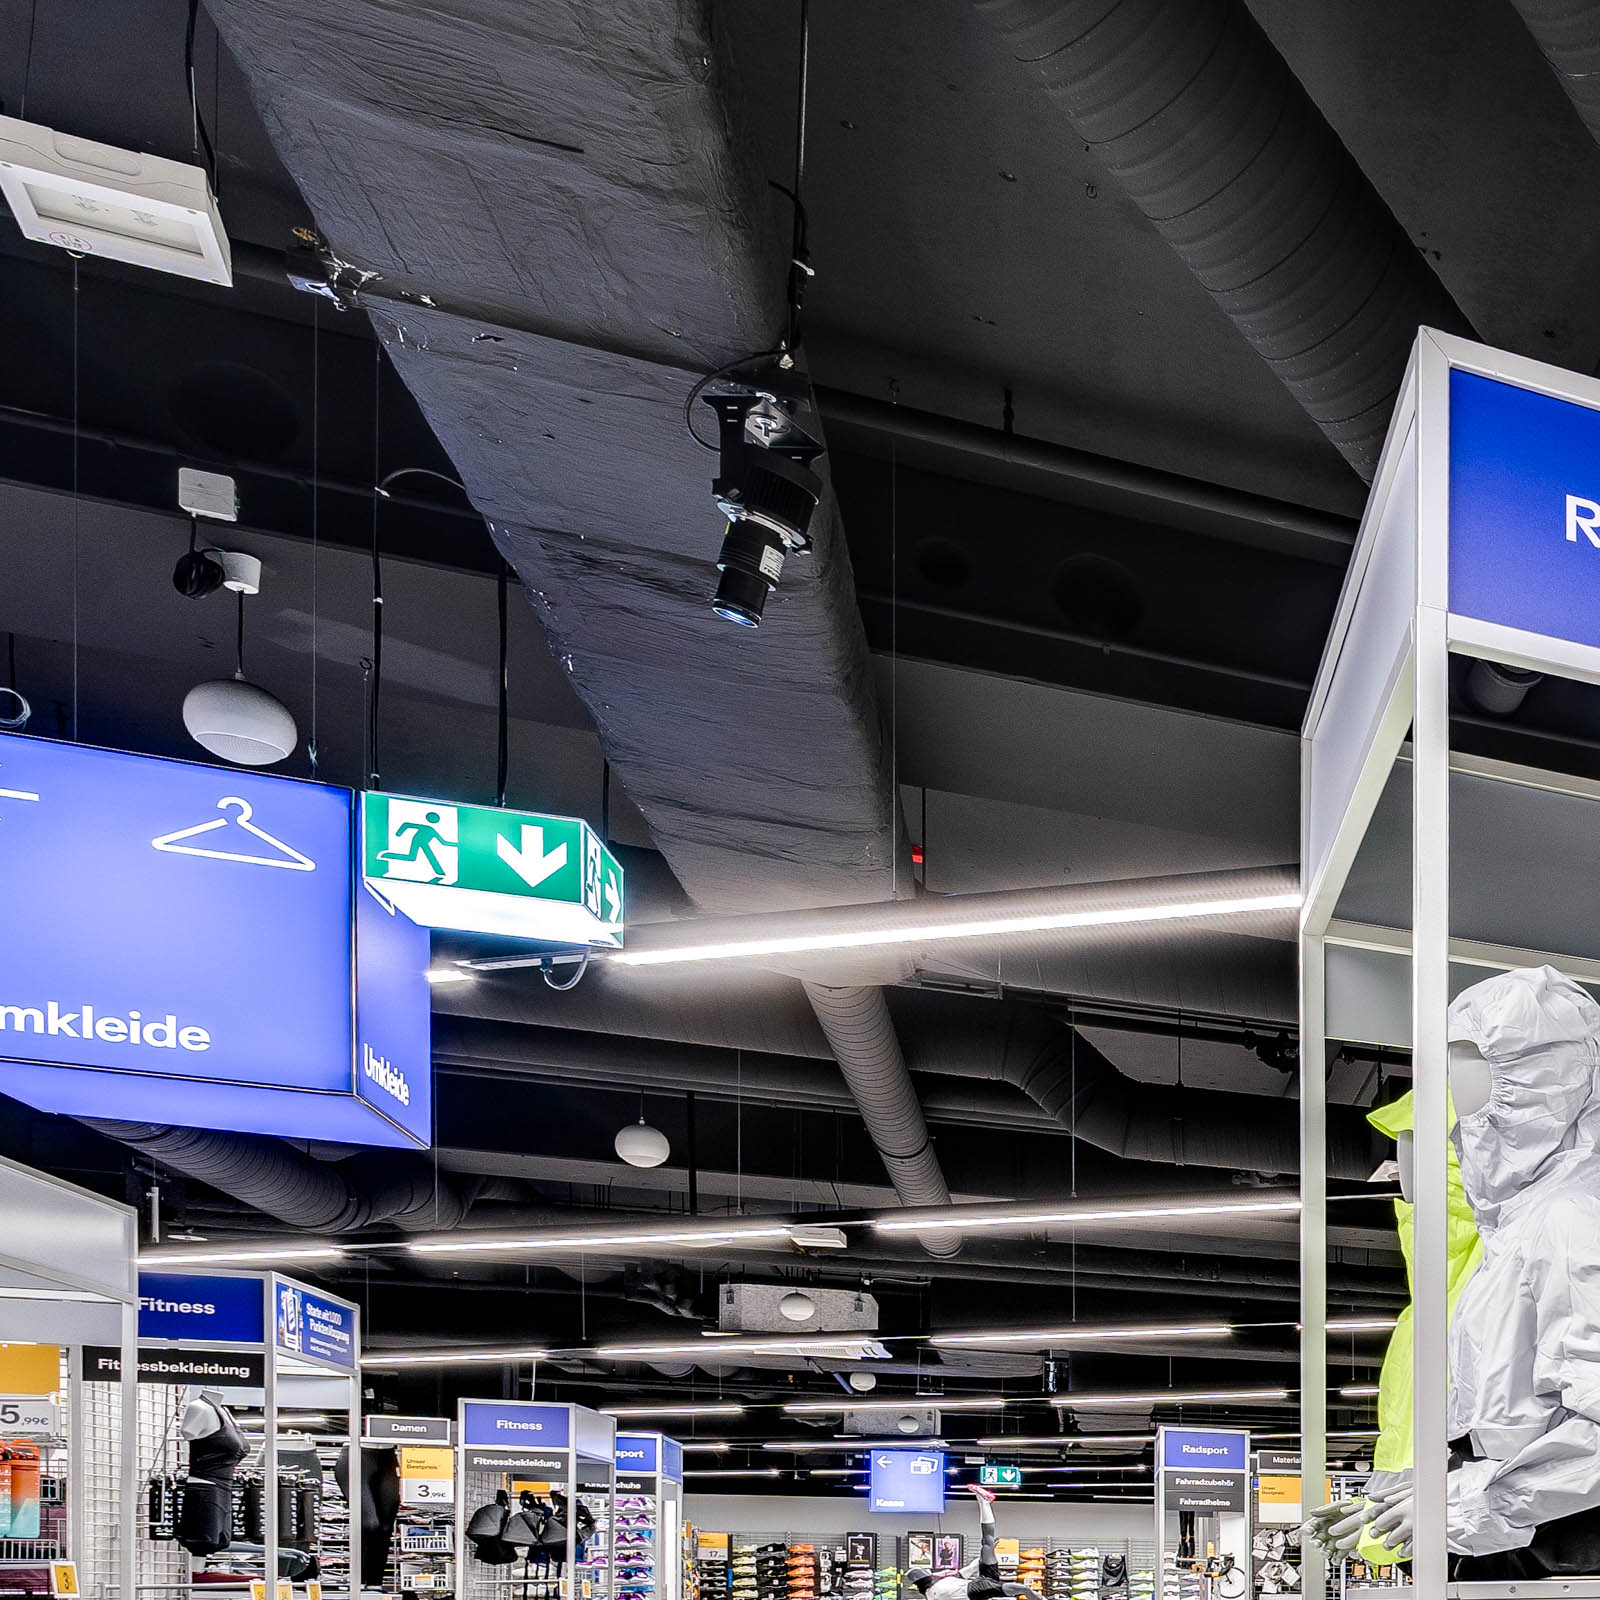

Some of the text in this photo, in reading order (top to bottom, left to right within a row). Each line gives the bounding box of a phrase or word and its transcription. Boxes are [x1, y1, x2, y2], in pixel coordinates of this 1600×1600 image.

[363, 1043, 410, 1106] Umkleide
[138, 1297, 216, 1315] Fitness
[98, 1358, 251, 1378] Fitessbekleidung
[391, 1423, 427, 1433] Damen
[496, 1419, 543, 1431] Fitness
[1182, 1444, 1229, 1455] Radsport
[473, 1457, 562, 1469] Fitnessbekleidung
[1175, 1477, 1235, 1487] Fahrradzubehör
[1179, 1497, 1231, 1506] Fahrradhelme
